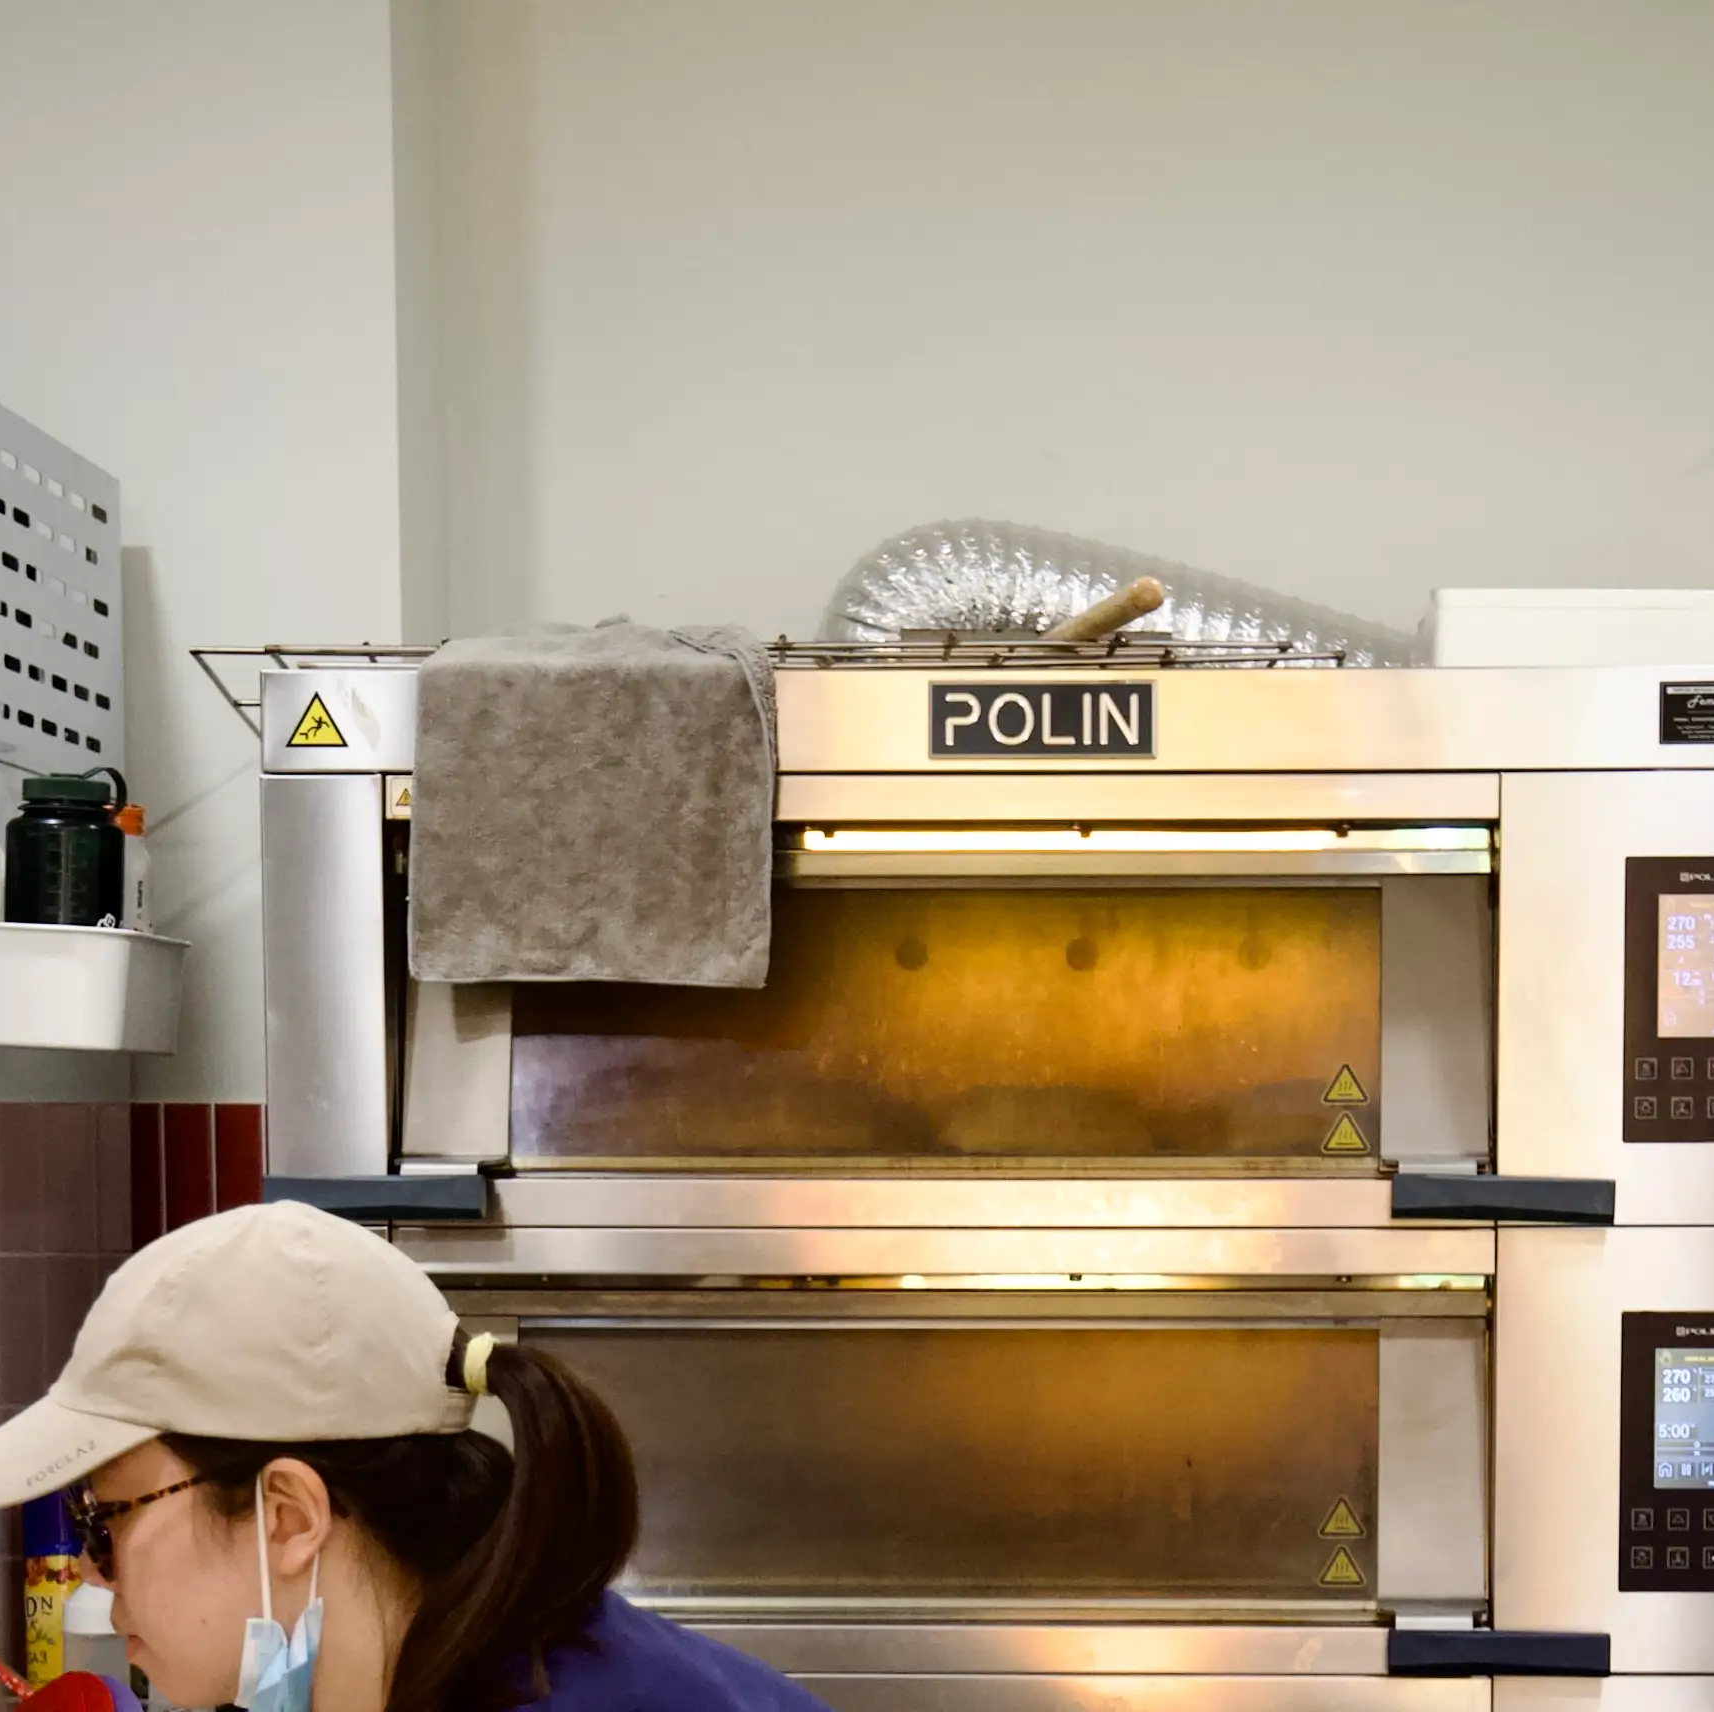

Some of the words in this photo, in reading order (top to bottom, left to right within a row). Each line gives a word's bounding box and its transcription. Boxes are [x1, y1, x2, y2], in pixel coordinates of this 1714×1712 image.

[945, 692, 1140, 746] POLIN
[1667, 915, 1696, 931] 270
[1667, 934, 1695, 949] 255
[1662, 1368, 1691, 1385] 270
[1662, 1387, 1691, 1402] 260
[1658, 1424, 1690, 1438] 5:00
